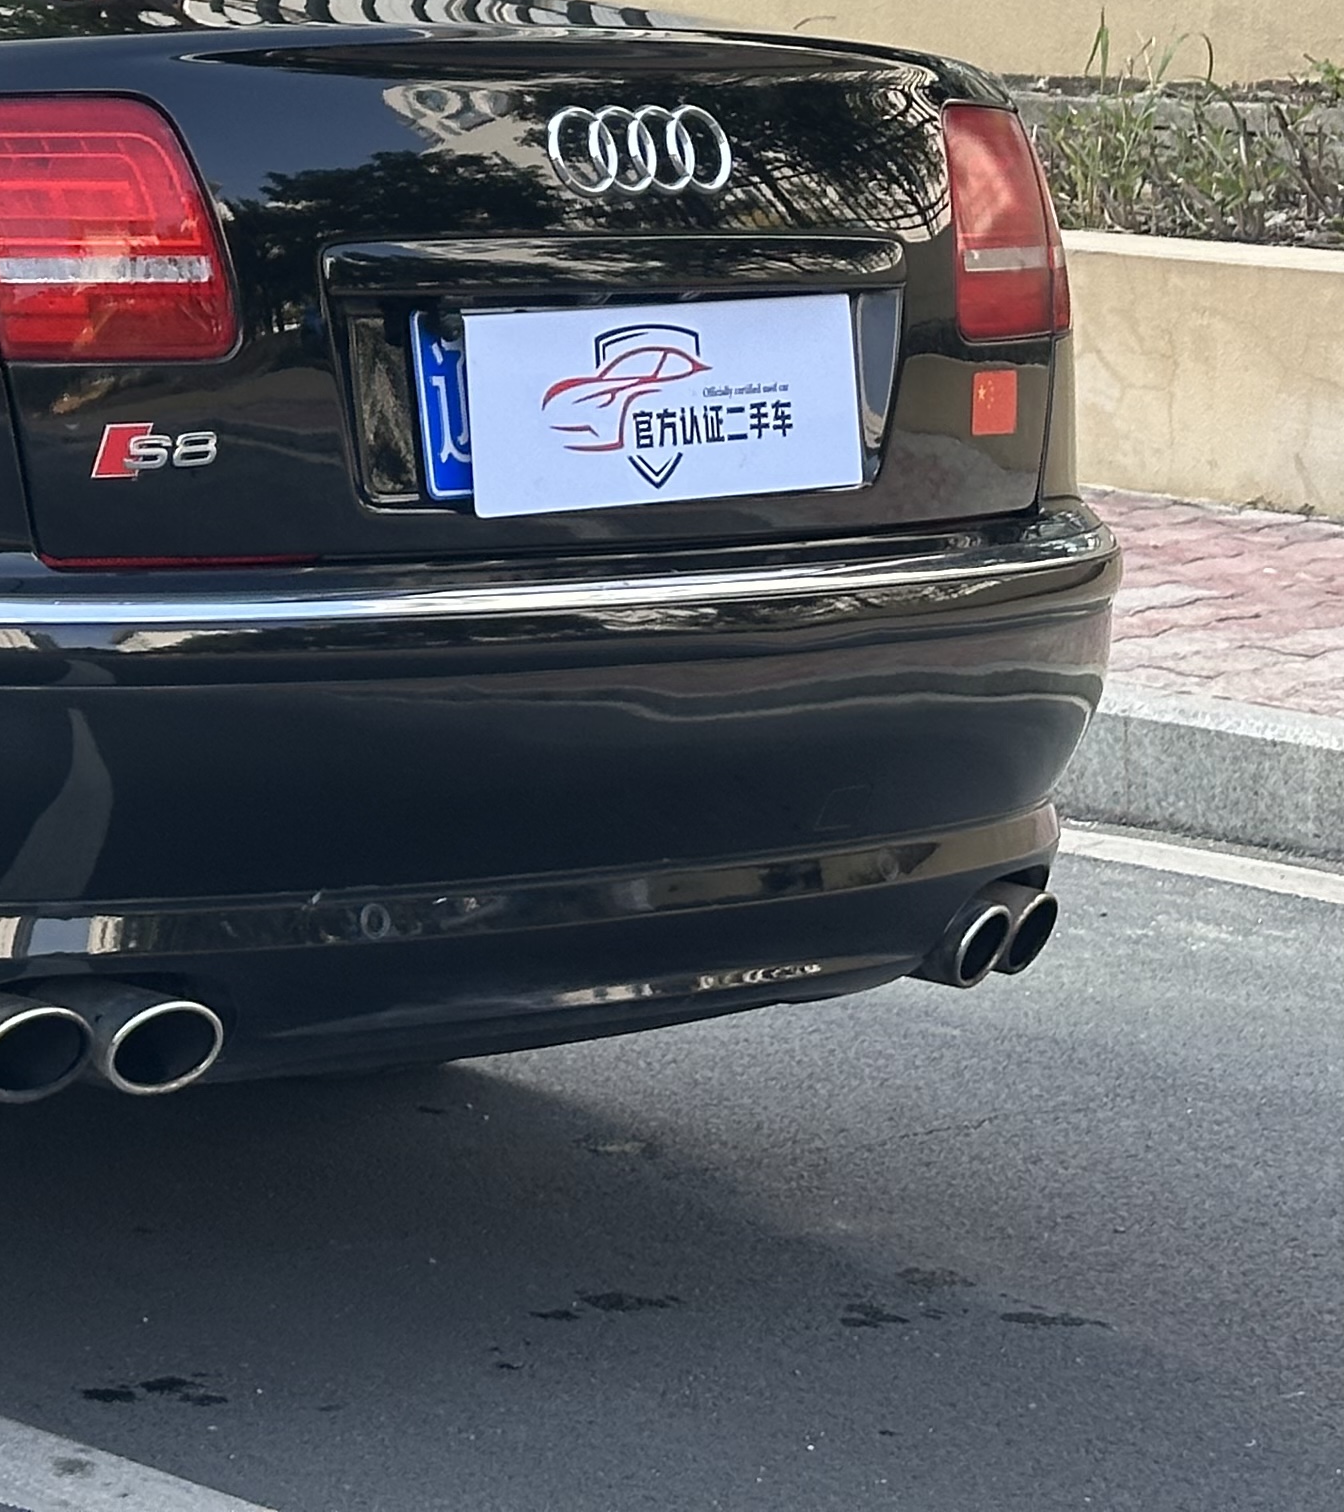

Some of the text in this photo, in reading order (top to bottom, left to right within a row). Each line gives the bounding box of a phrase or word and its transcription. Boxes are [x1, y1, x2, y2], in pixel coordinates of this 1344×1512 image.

[633, 400, 794, 449] 官方认证二手车
[123, 431, 218, 470] S8
